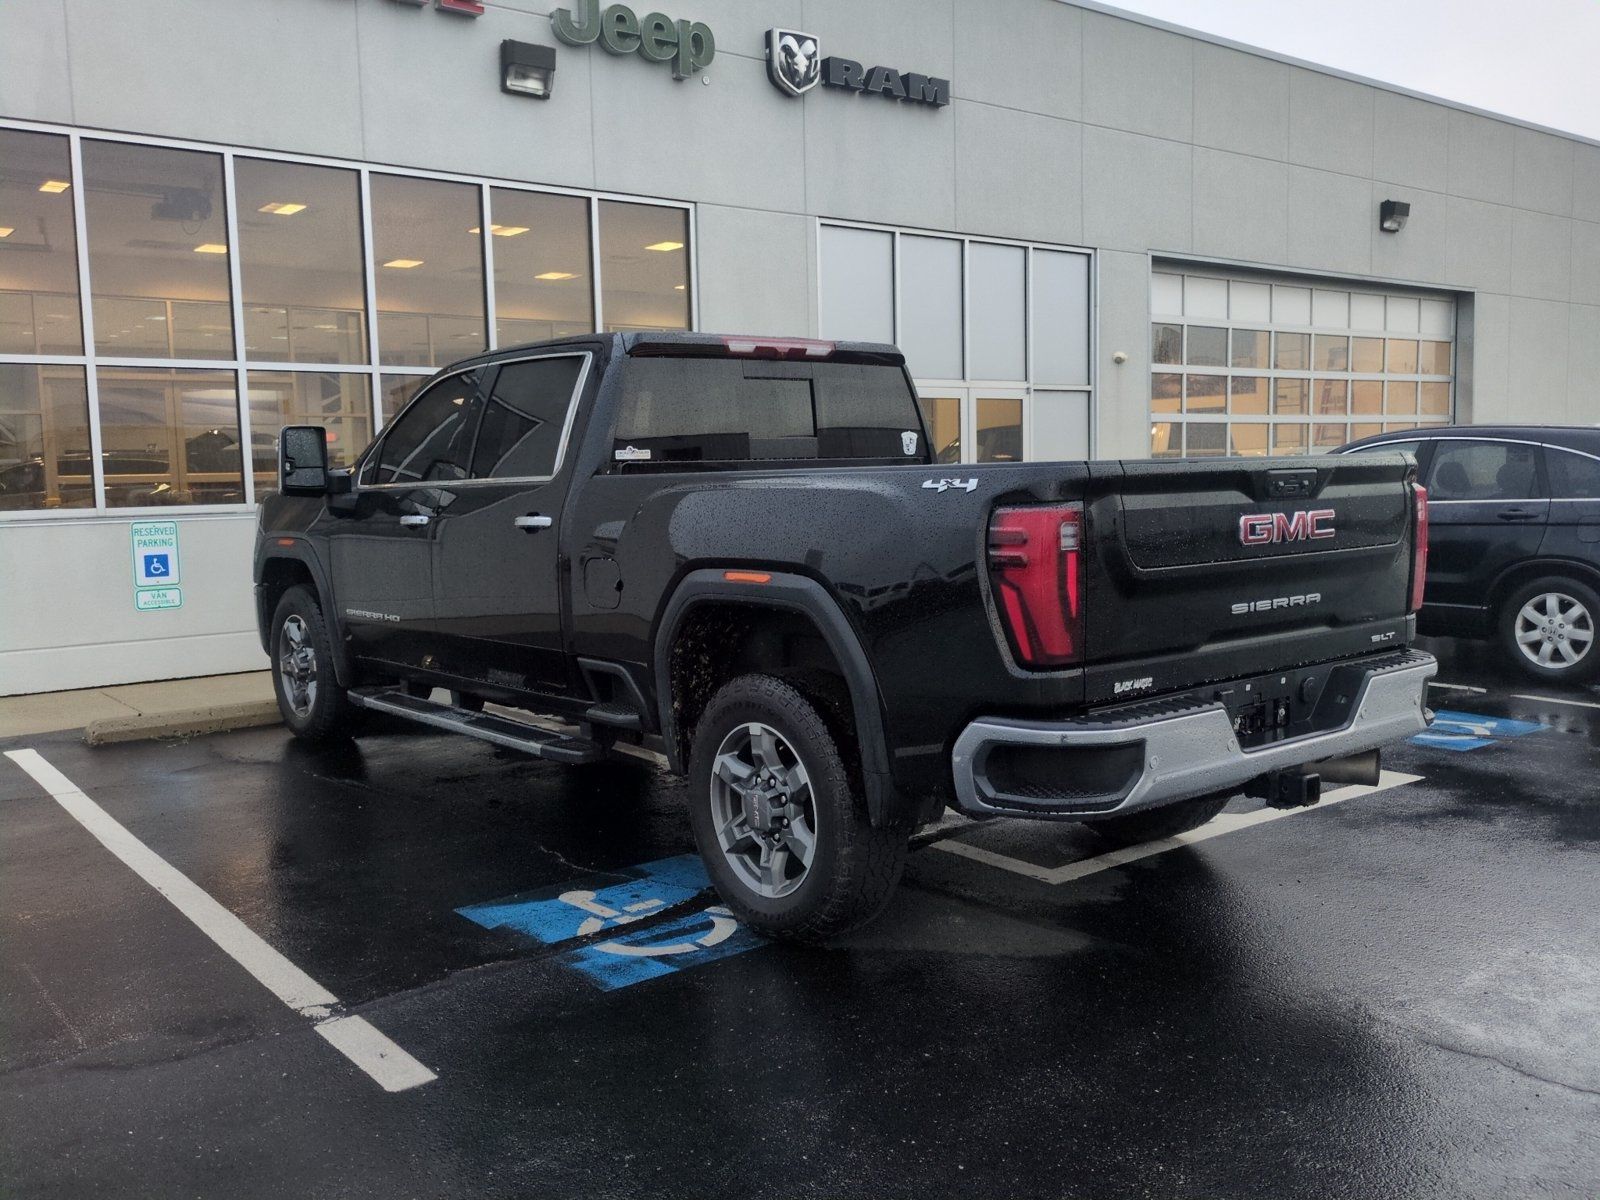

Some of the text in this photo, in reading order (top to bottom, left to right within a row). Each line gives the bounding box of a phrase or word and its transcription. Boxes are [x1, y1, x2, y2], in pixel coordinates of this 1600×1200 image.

[550, 0, 715, 81] Jeep
[821, 56, 951, 108] RAM
[133, 527, 175, 537] RESERVED
[1239, 508, 1336, 546] GMC
[137, 538, 173, 548] PARKING
[1231, 592, 1322, 615] SIERRA
[346, 608, 401, 622] SIERRA HD
[1371, 631, 1396, 643] SLT
